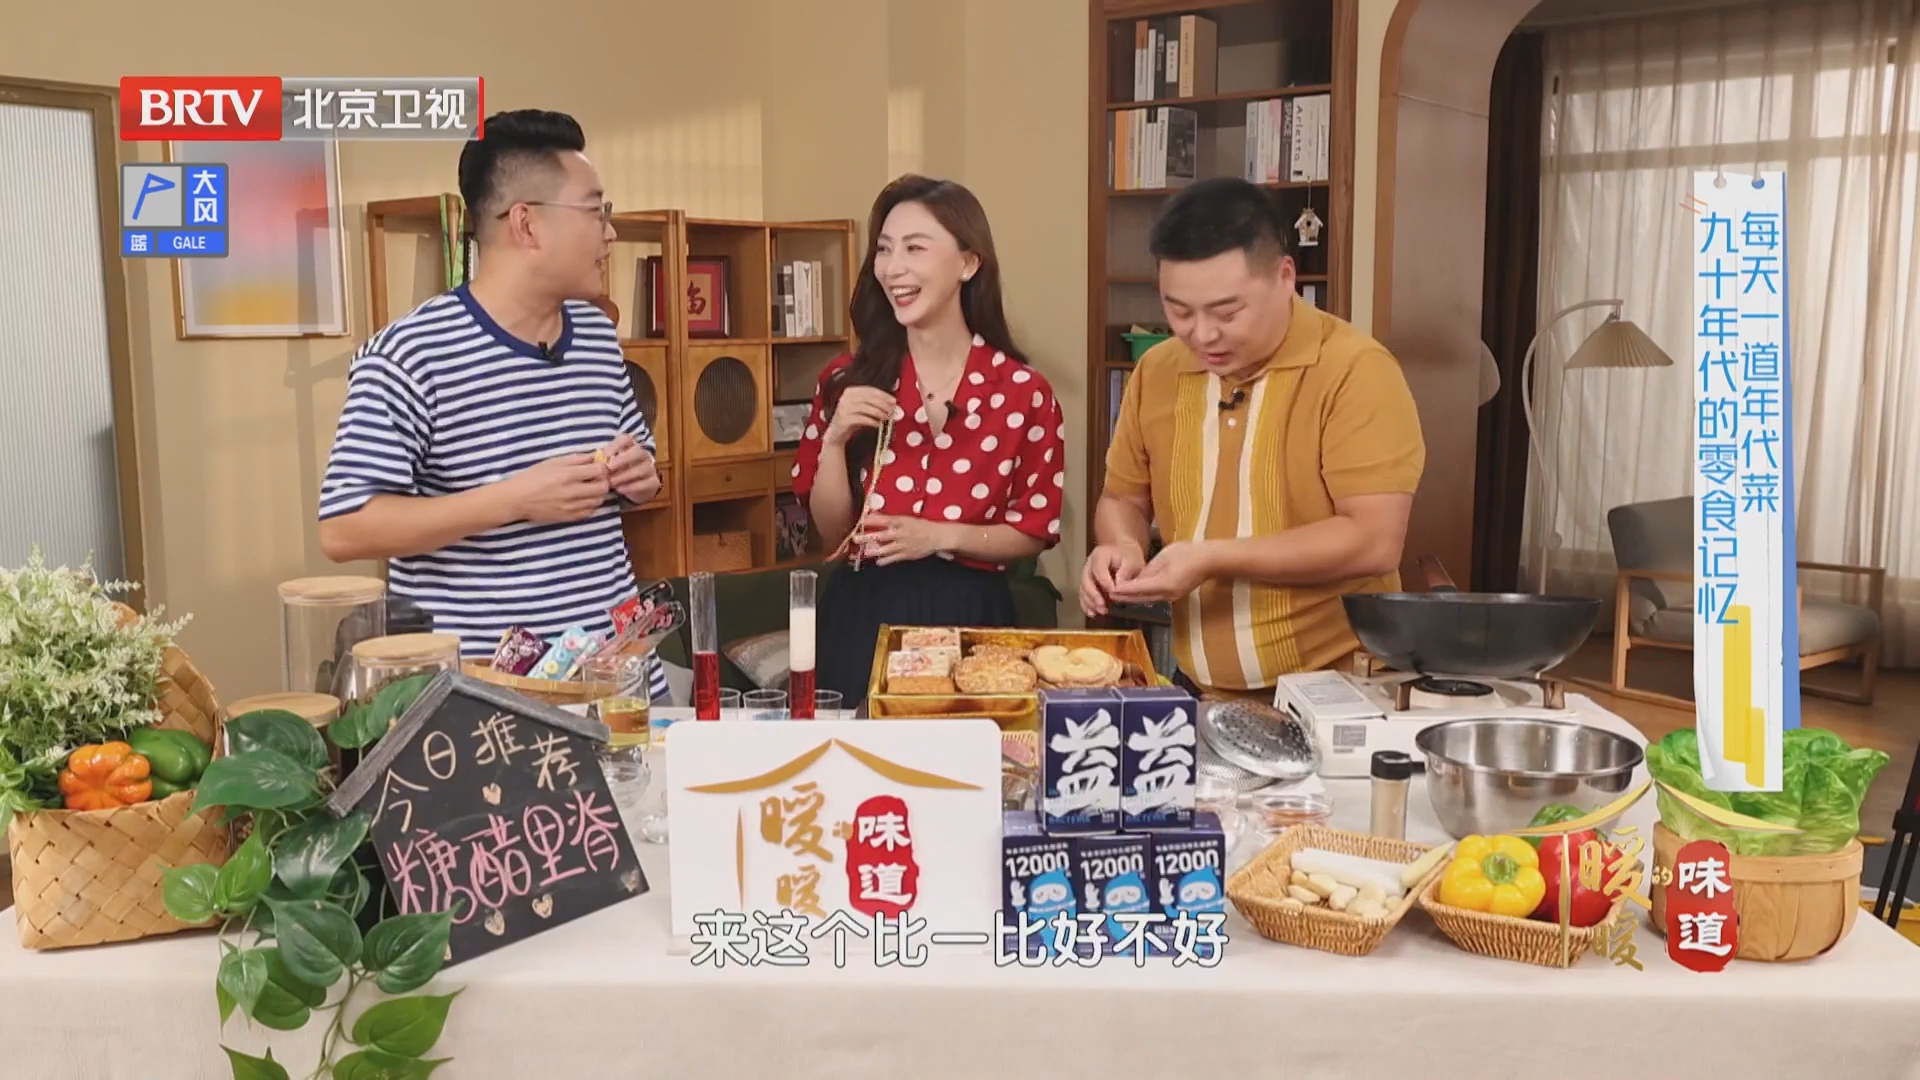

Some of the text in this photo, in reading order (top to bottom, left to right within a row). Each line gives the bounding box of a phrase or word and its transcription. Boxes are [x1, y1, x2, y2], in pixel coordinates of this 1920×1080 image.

[370, 711, 581, 834] 今日推荐
[387, 790, 620, 924] 糖醋里脊
[1005, 851, 1070, 879] 12000
[1080, 853, 1144, 881] 12000
[1155, 849, 1219, 876] 12000
